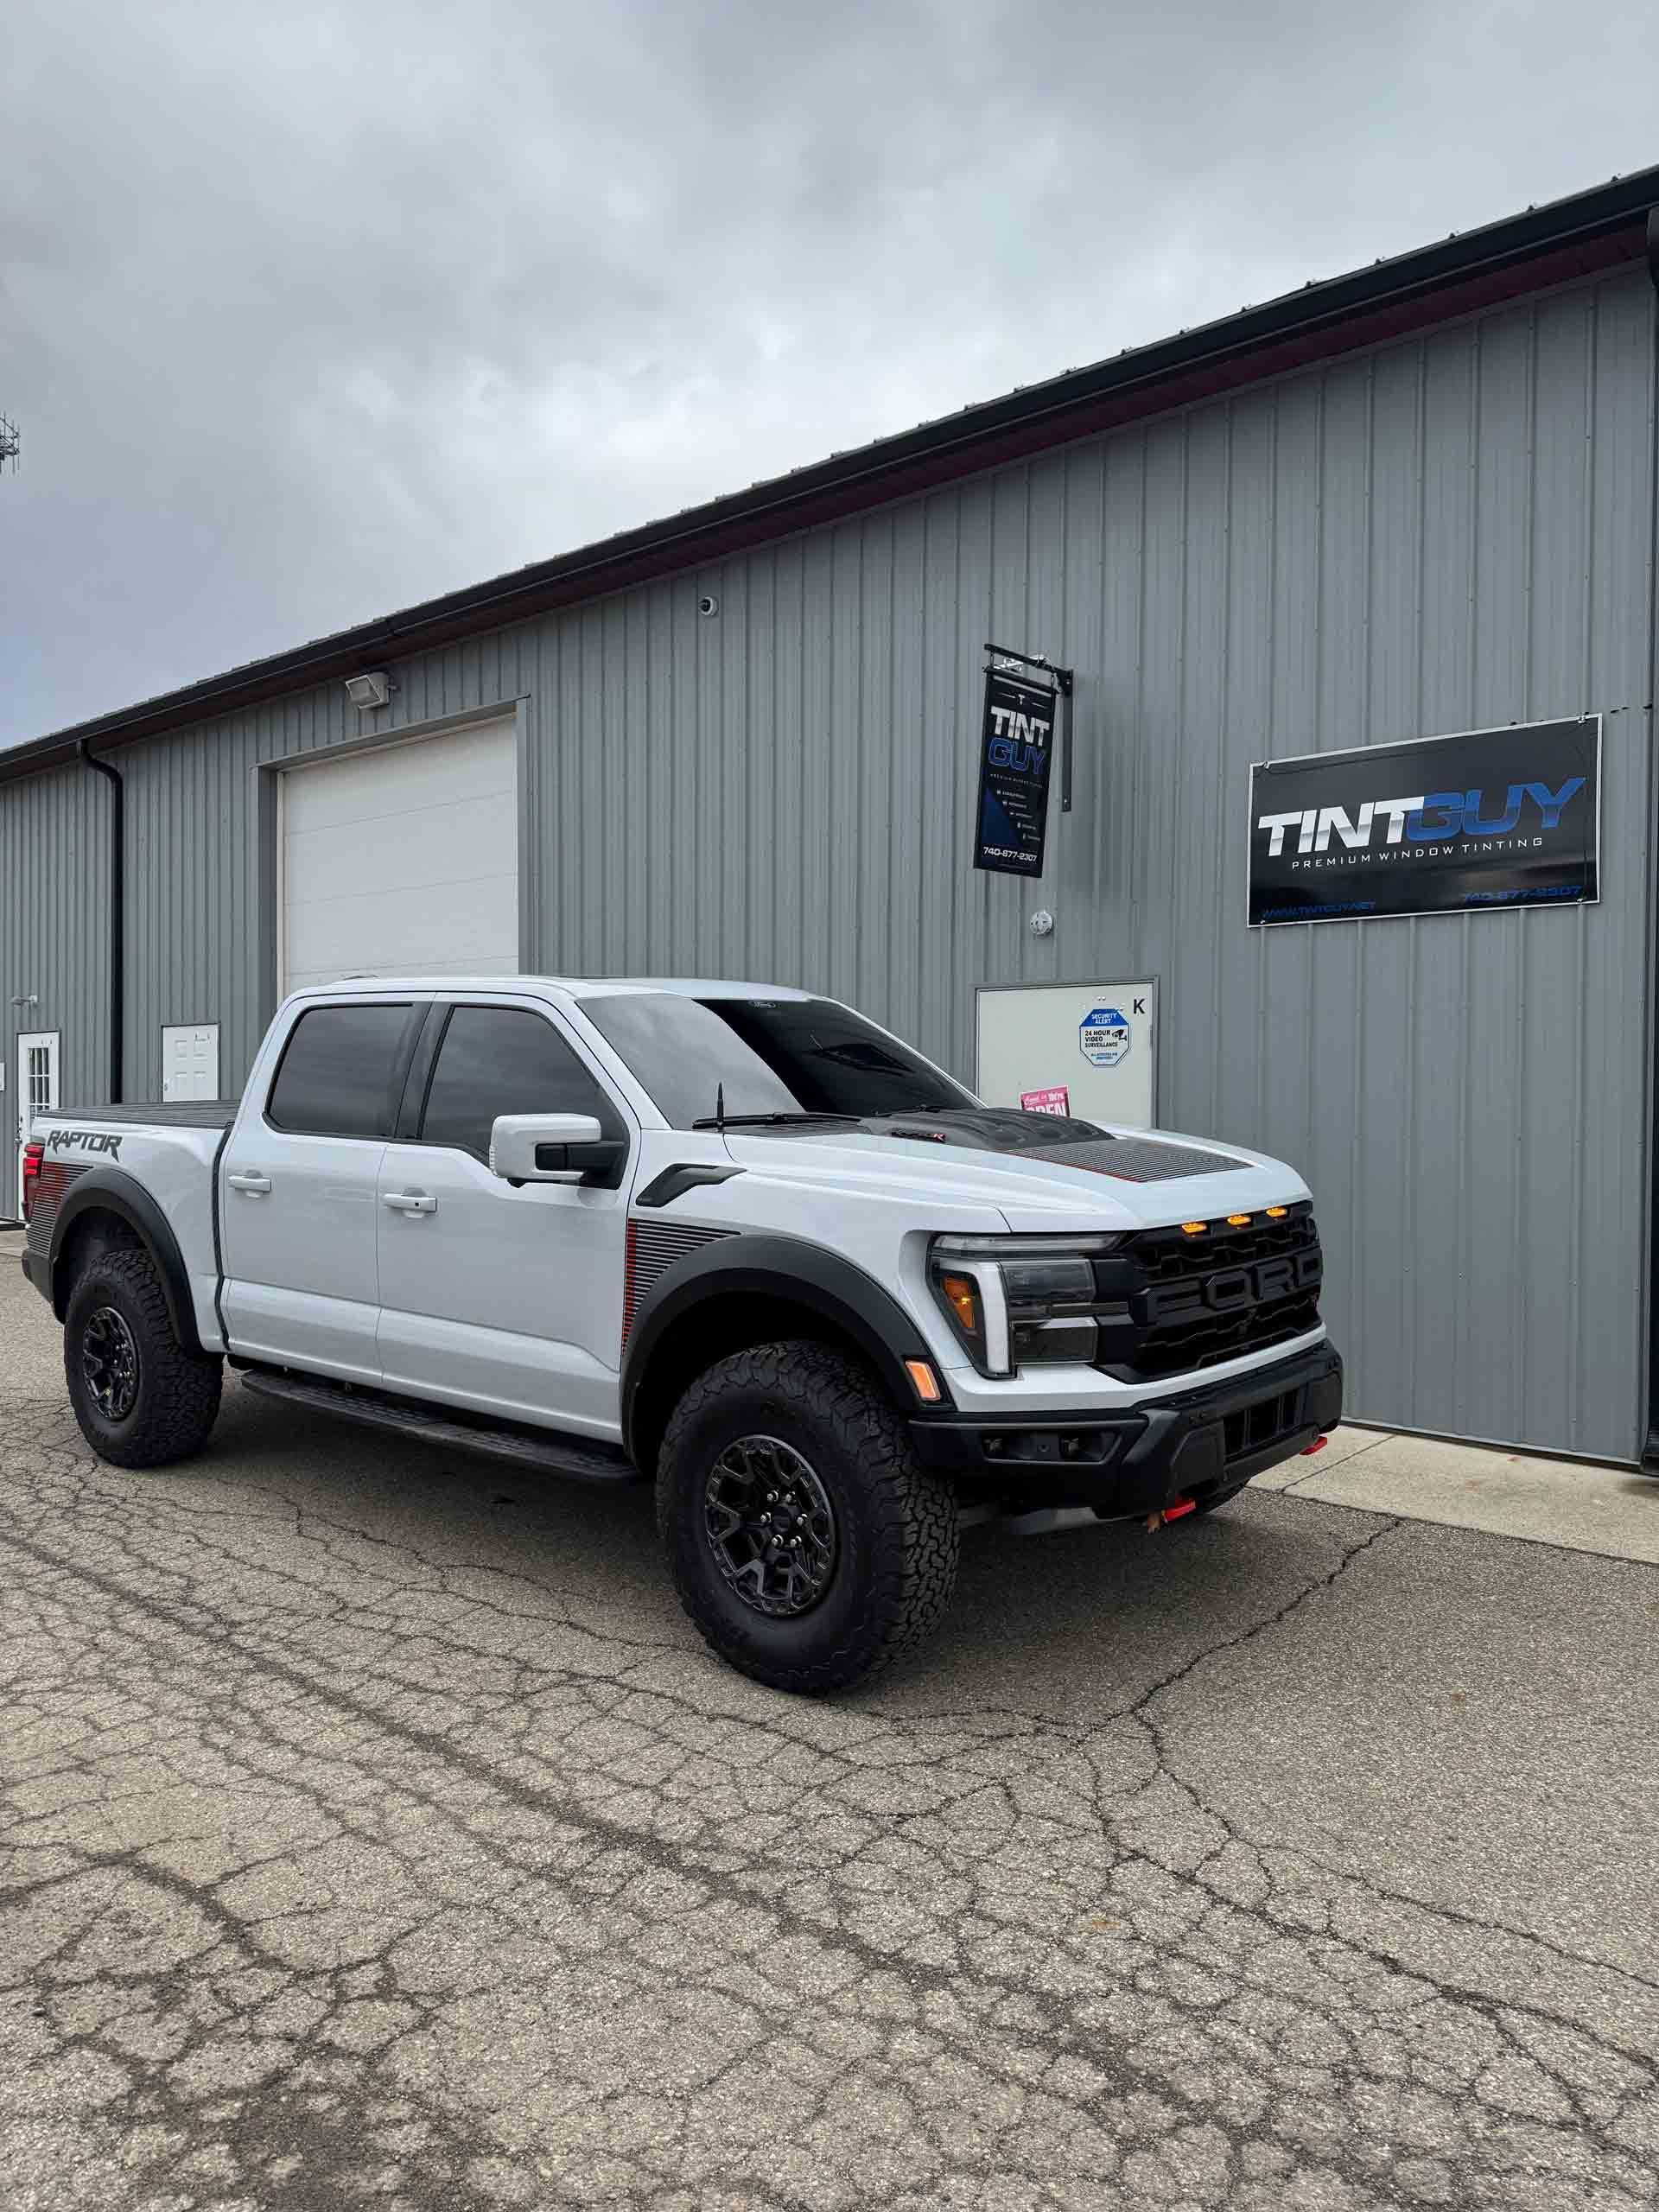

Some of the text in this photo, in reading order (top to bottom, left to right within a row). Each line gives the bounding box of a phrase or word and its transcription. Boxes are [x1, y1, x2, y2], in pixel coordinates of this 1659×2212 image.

[991, 706, 1050, 747] TINT
[988, 737, 1046, 775] GUY
[1258, 777, 1587, 857] TINTGUY
[983, 847, 1037, 862] 740-877-2307
[1292, 836, 1543, 870] PREMIUM WINDOW TINTING
[1133, 998, 1147, 1014] K
[48, 1129, 123, 1163] RAPTOR
[1147, 1249, 1323, 1328] FORD
